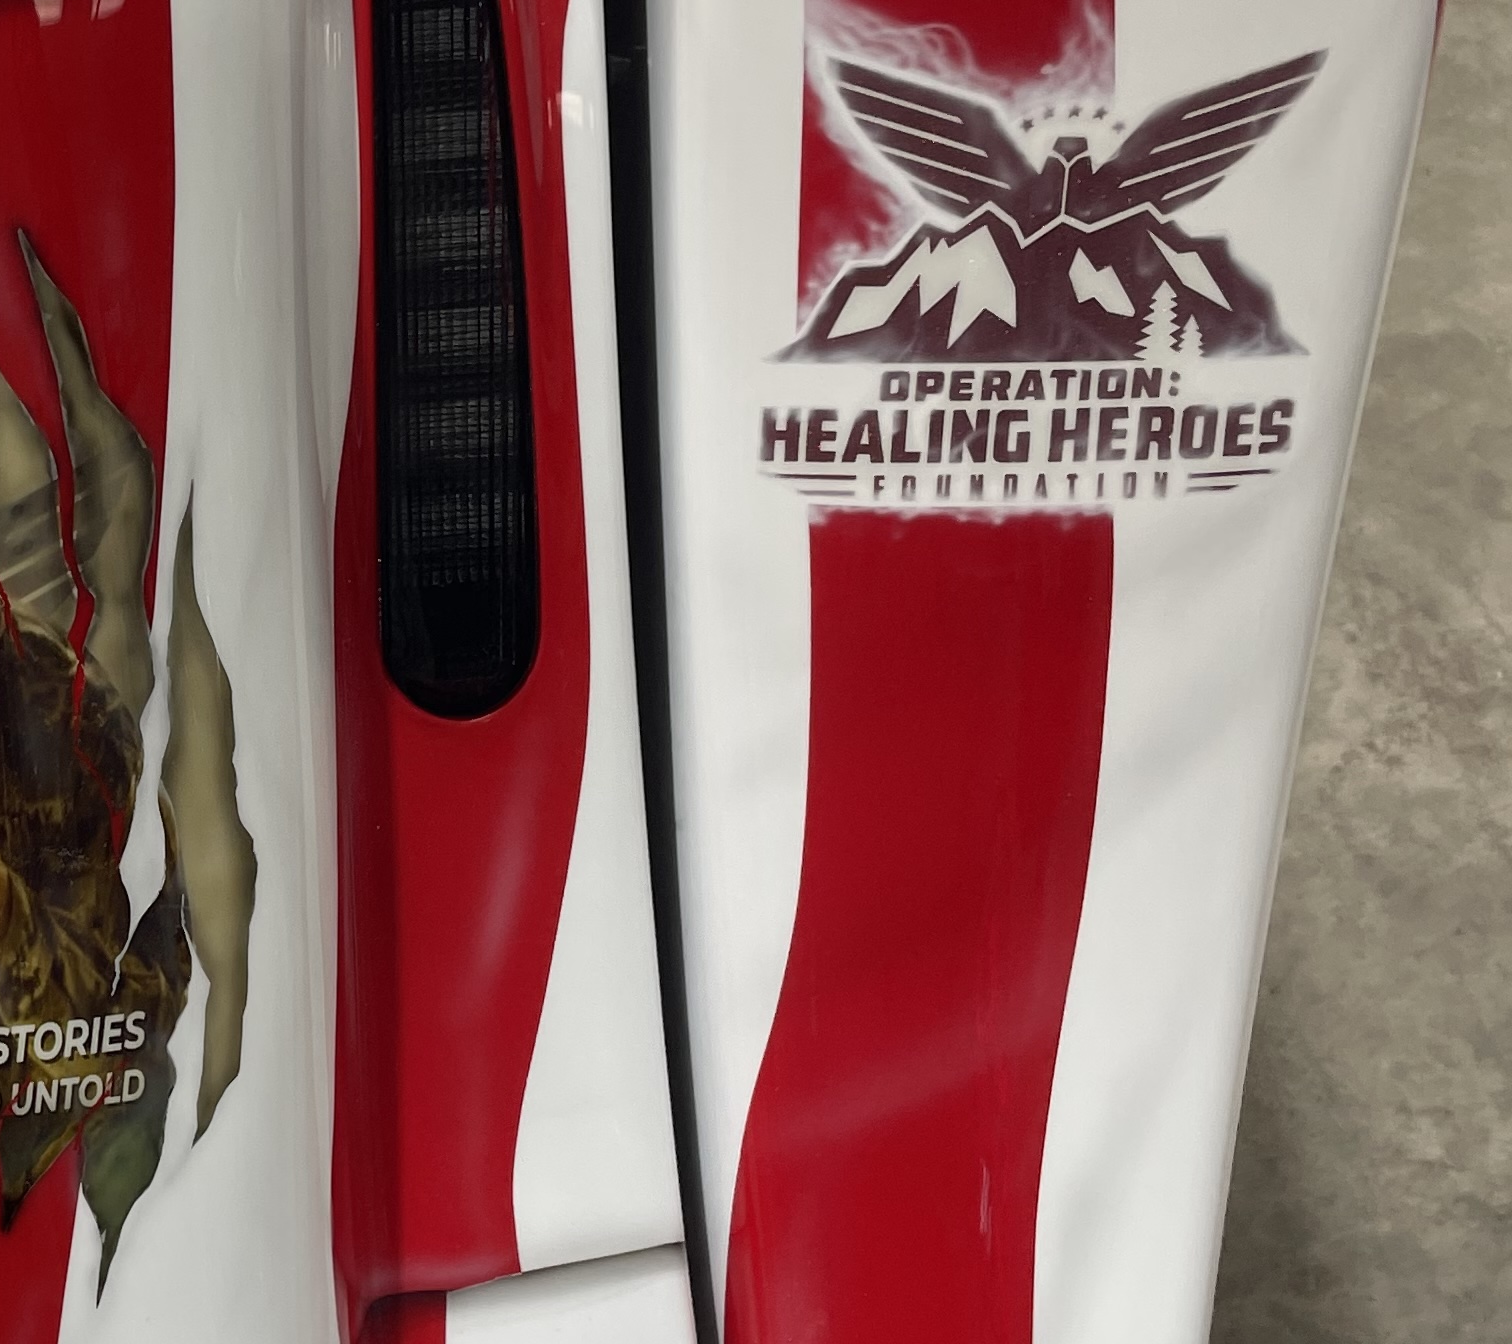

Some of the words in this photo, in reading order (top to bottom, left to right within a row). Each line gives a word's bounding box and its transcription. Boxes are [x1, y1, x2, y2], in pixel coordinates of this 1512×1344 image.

[880, 367, 1181, 401] OPERATION:
[760, 406, 1032, 464] HEALING
[1047, 398, 1295, 463] HEROES
[873, 470, 1169, 500] FOUNDATION
[10, 1069, 145, 1115] UNTOLD
